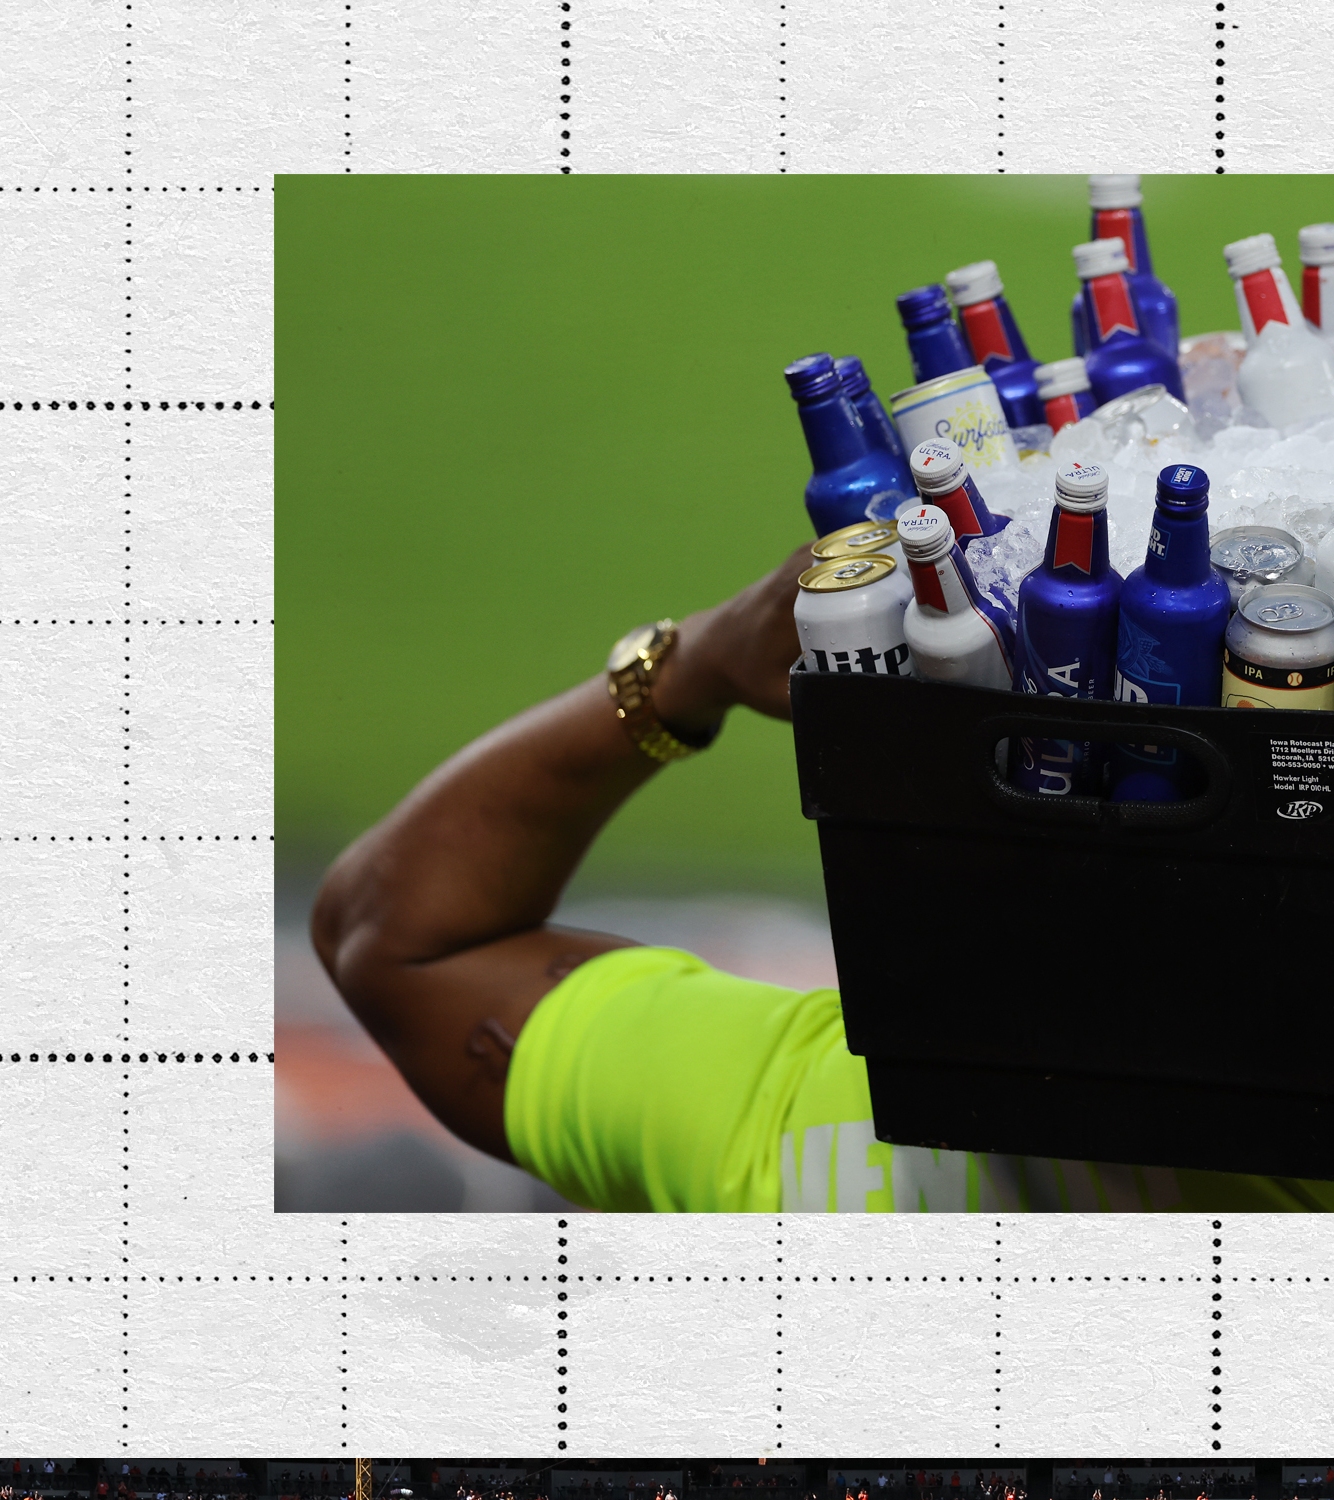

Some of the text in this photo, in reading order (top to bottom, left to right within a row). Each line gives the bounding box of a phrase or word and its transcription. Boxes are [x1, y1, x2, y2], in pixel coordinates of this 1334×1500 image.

[1244, 664, 1263, 680] IPA
[1272, 761, 1321, 769] 800-553-0050
[1273, 774, 1319, 784] Hawker Light
